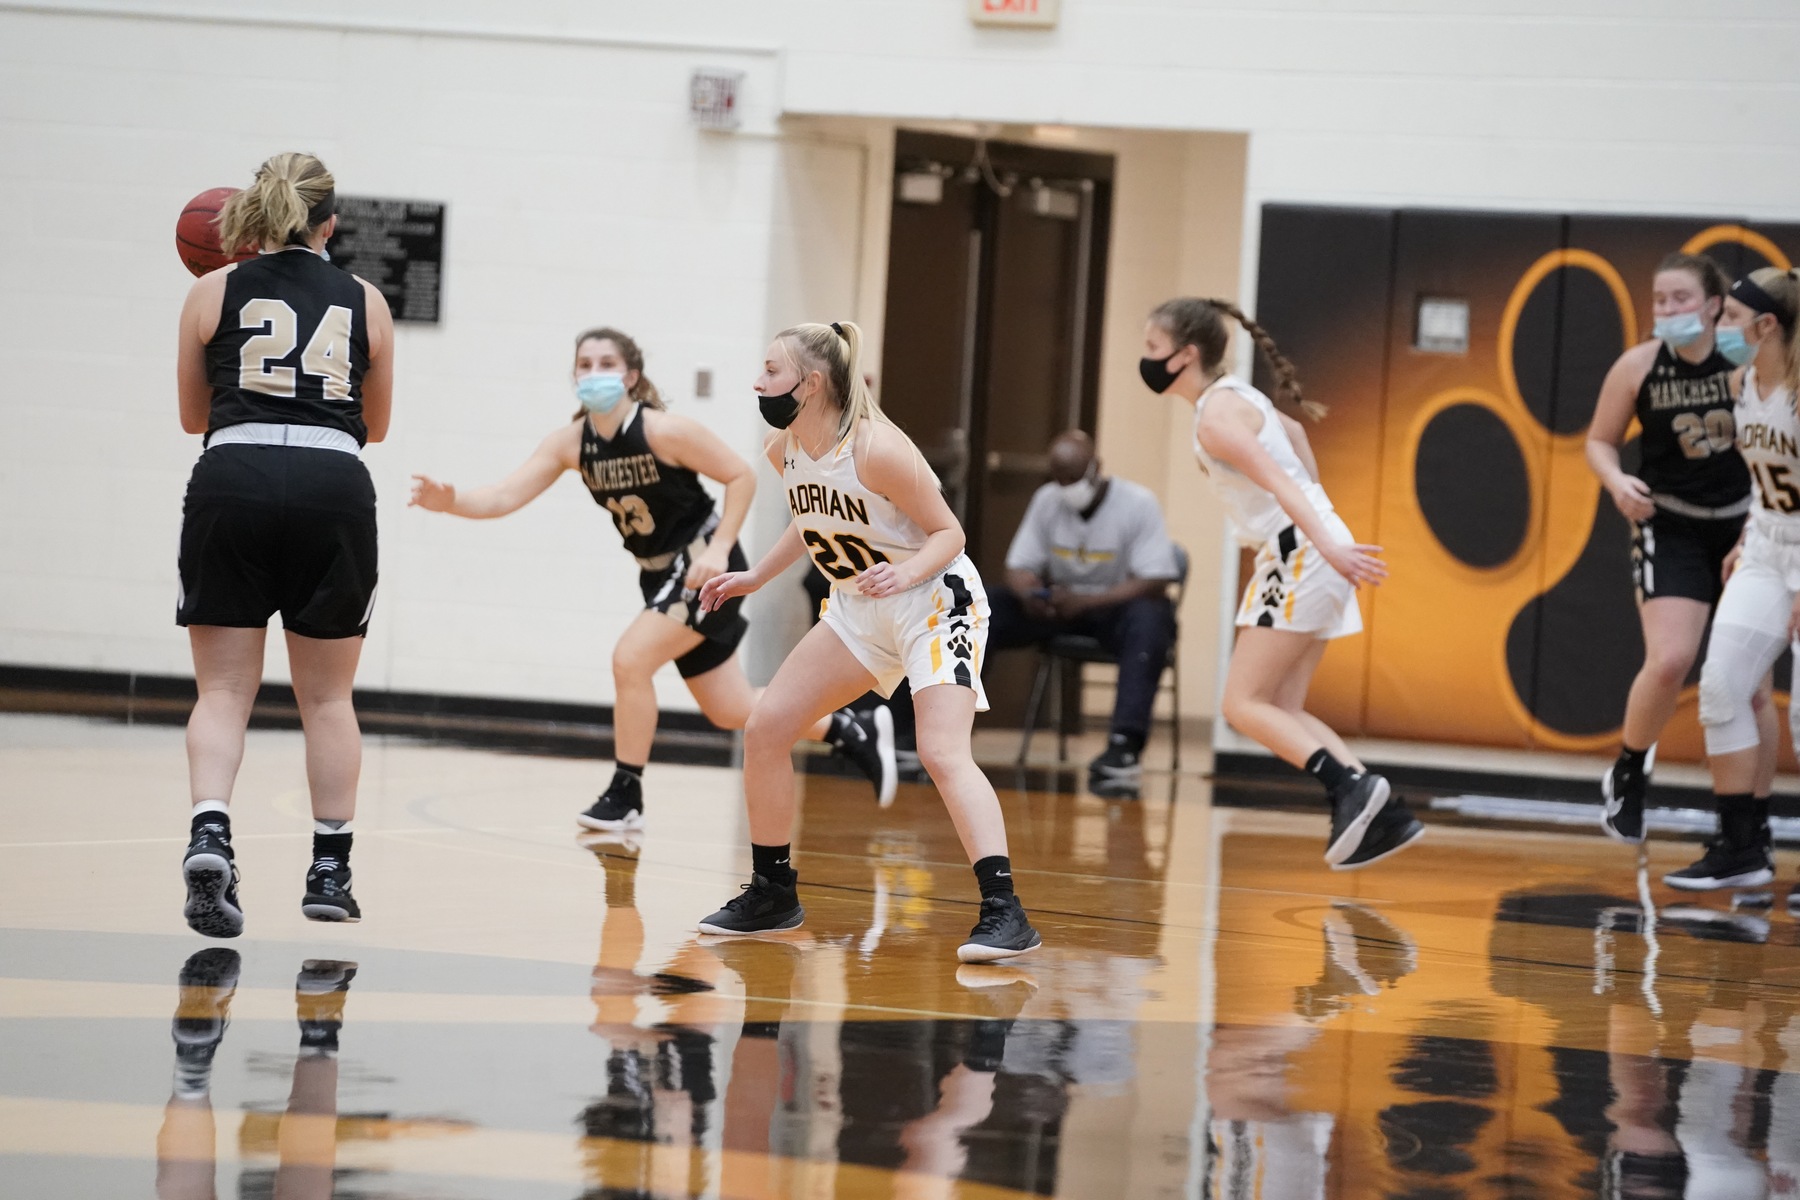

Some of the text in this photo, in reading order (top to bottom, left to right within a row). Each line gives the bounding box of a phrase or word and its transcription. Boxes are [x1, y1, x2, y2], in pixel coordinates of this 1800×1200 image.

[239, 298, 354, 401] 24
[1649, 371, 1732, 410] MANCHEST
[1671, 408, 1736, 459] 20
[1743, 423, 1799, 458] DRIAN
[788, 483, 870, 525] ADRIAN
[1753, 462, 1800, 513] 15
[606, 494, 656, 538] 13
[802, 528, 893, 580] 20
